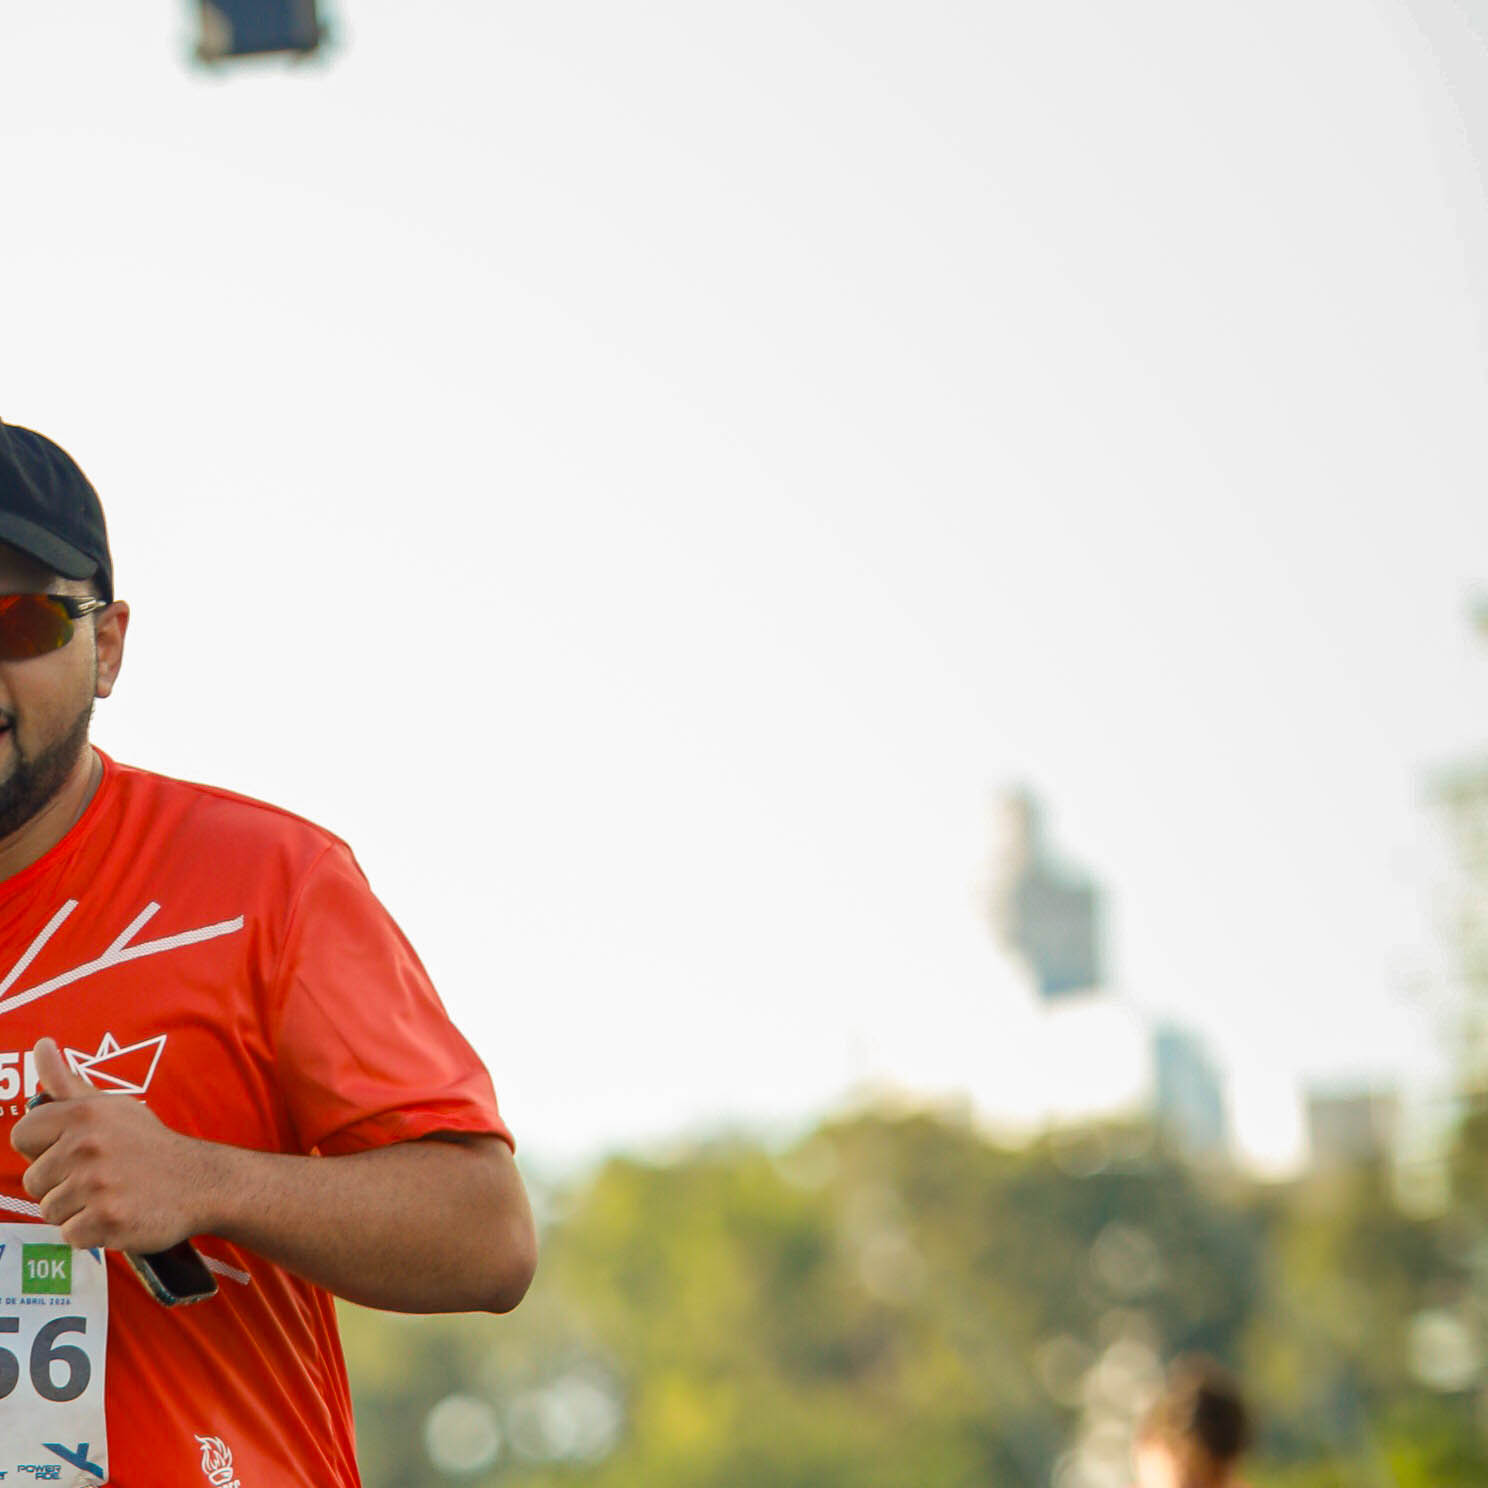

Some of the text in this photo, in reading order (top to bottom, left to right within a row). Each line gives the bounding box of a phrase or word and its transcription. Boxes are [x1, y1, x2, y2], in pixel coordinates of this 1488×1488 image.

[27, 1259, 66, 1280] 10K
[5, 1297, 17, 1305] DE
[20, 1297, 46, 1306] ABRIL
[17, 1464, 62, 1473] POWER
